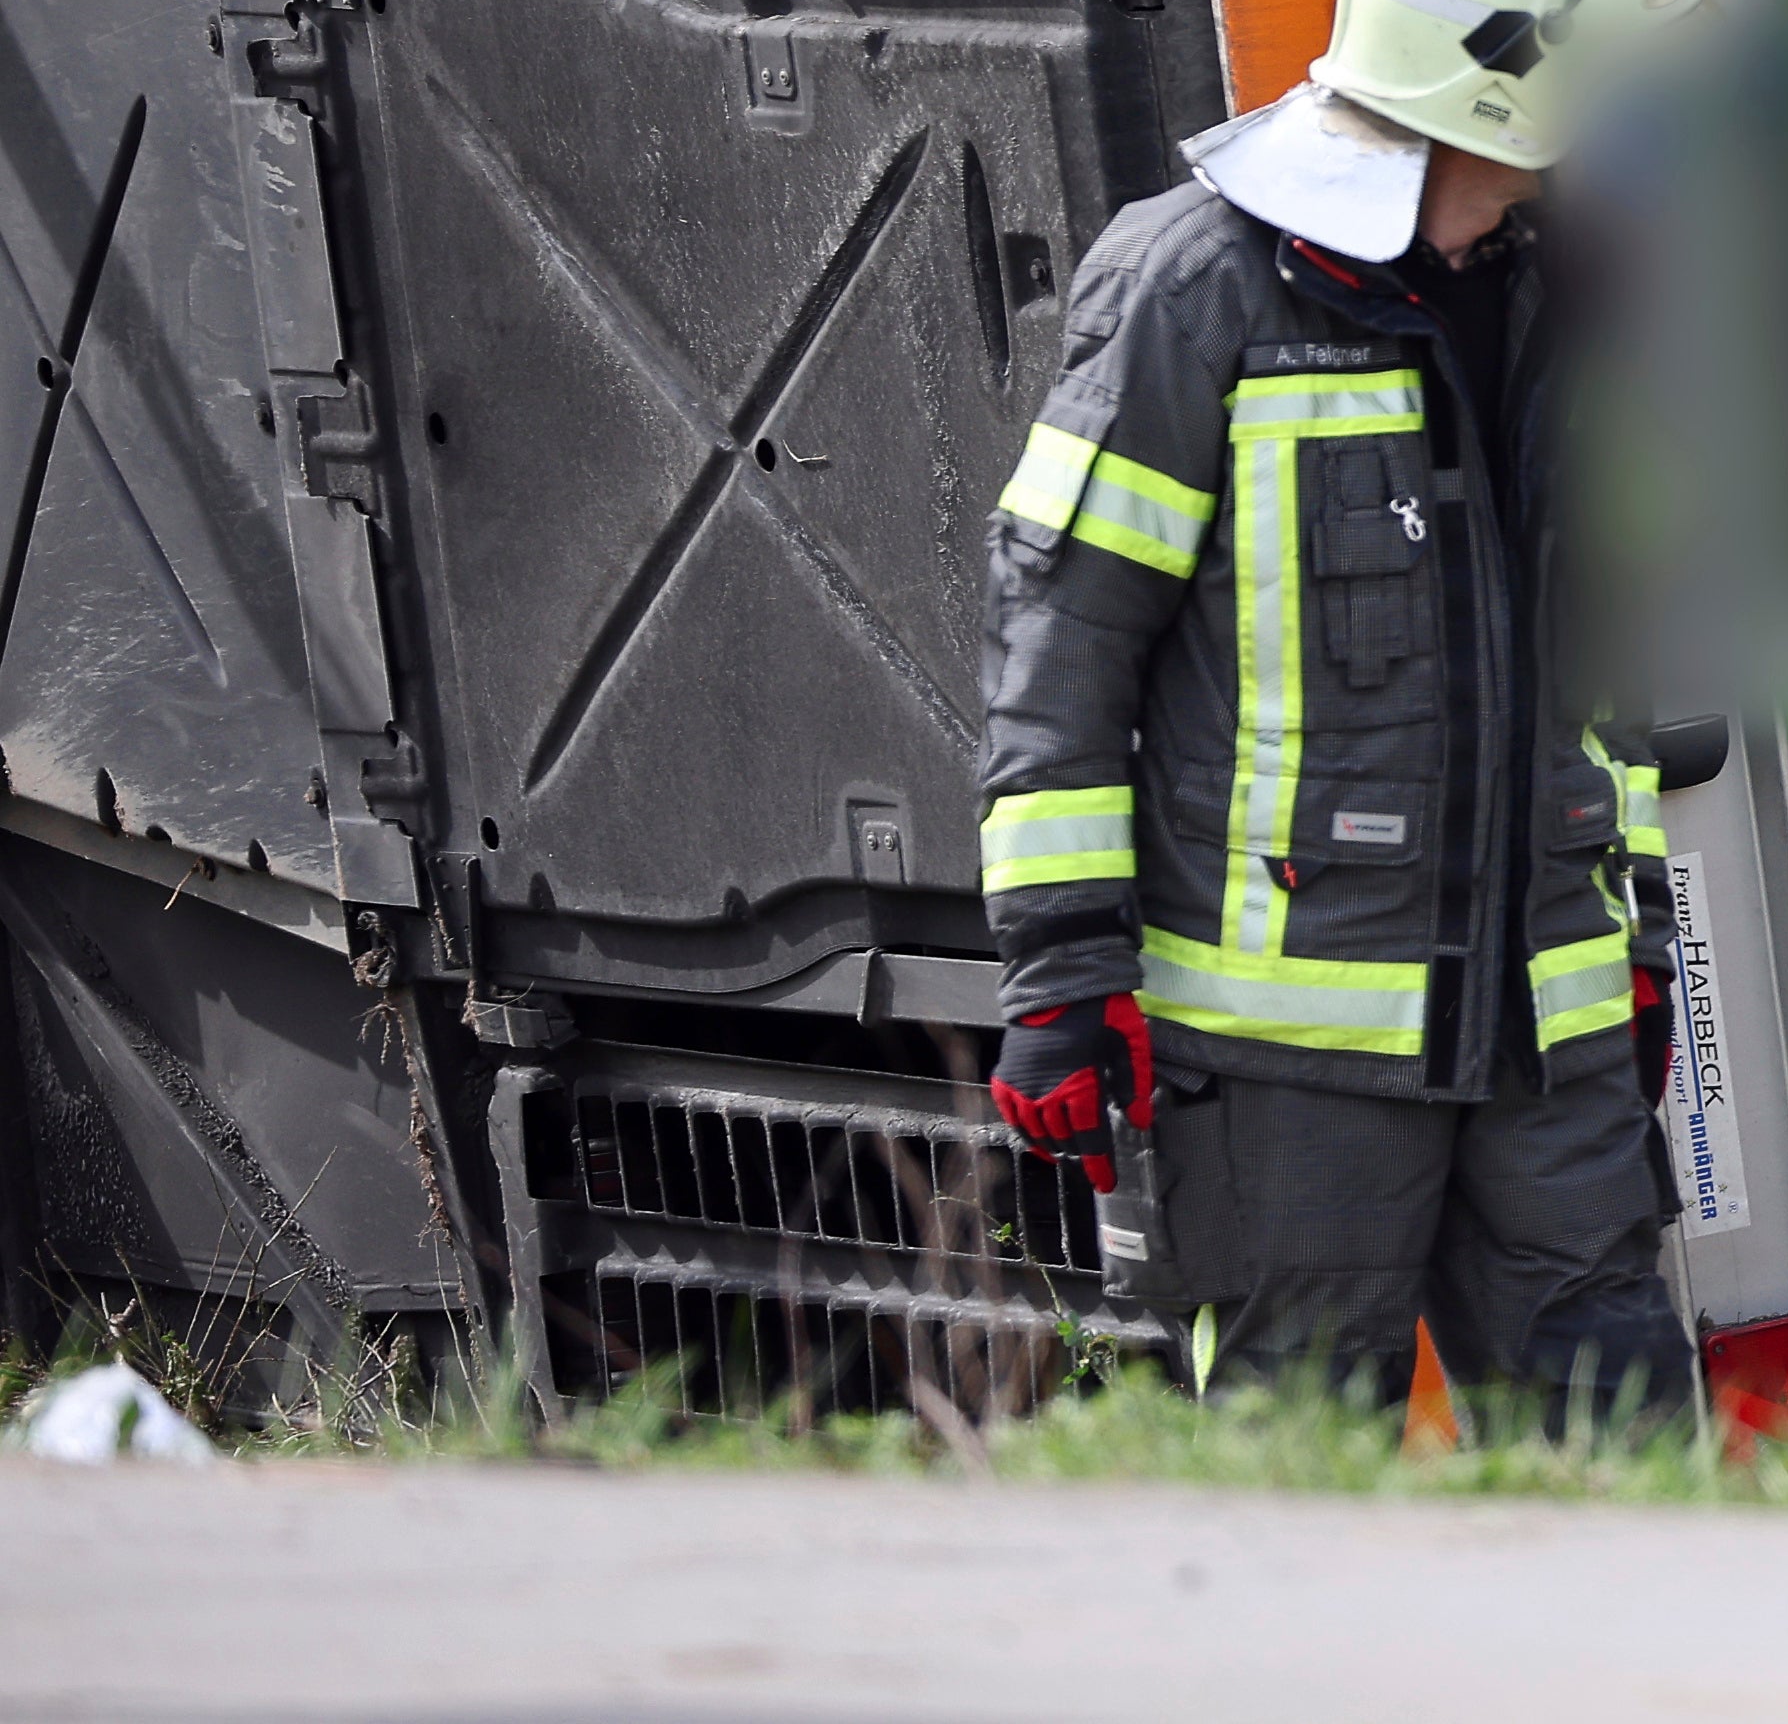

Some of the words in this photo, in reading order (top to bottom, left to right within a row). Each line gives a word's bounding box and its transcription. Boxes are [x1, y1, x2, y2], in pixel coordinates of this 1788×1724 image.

[1673, 866, 1693, 937] Franz
[1683, 940, 1725, 1107] HARBECK
[1670, 1055, 1689, 1104] Sport
